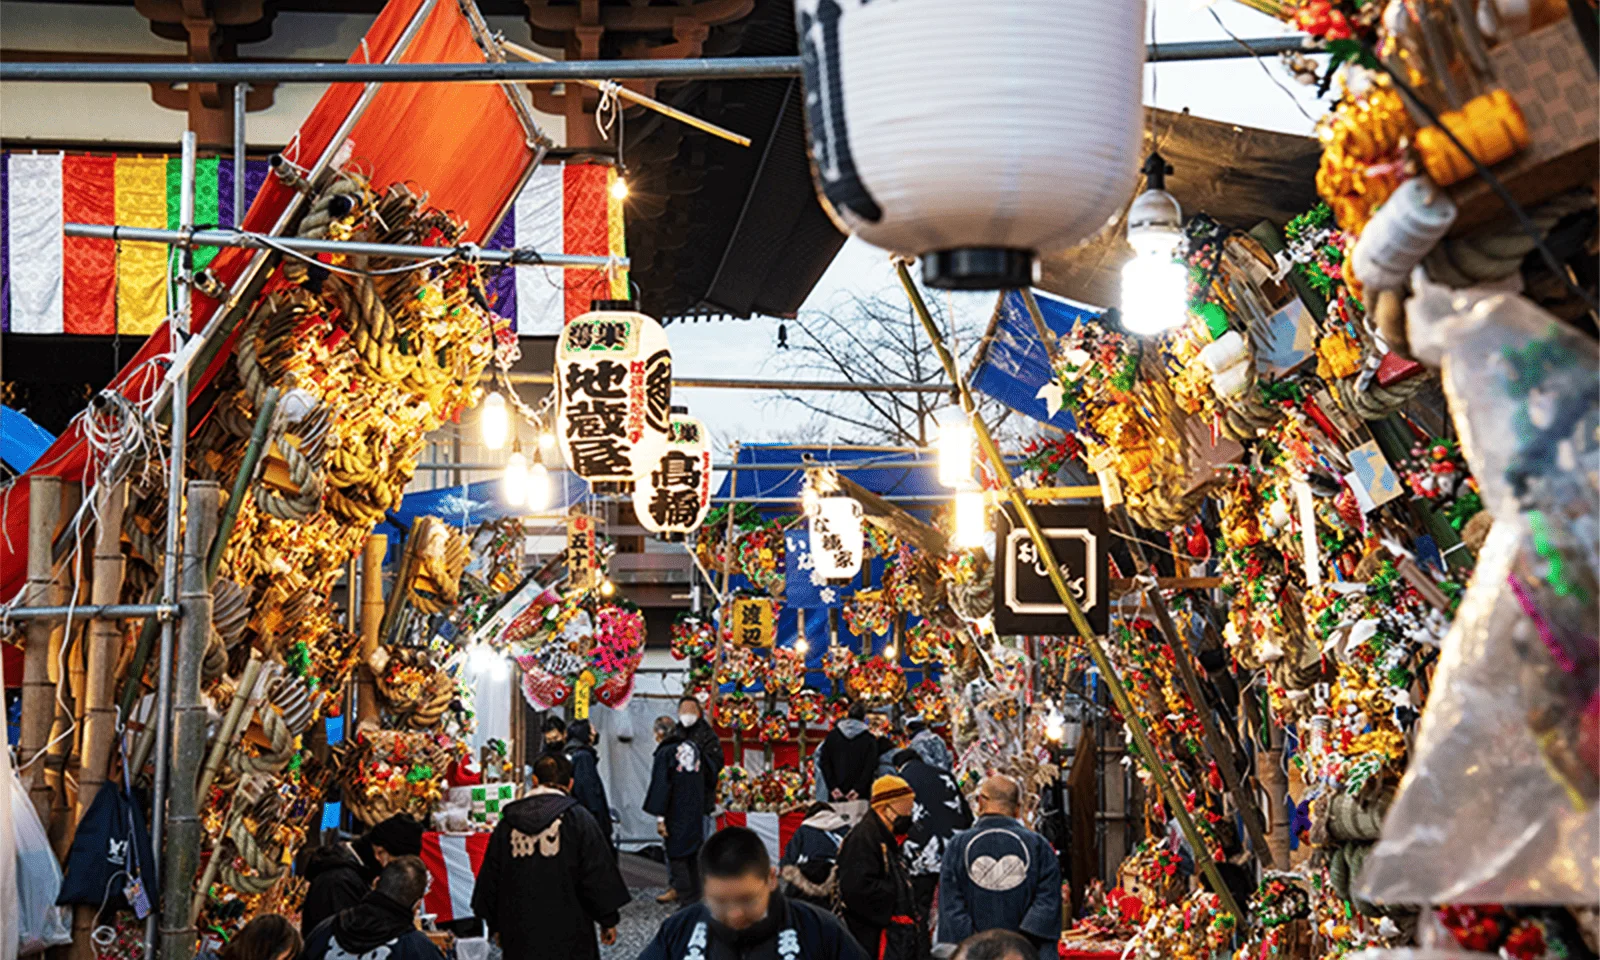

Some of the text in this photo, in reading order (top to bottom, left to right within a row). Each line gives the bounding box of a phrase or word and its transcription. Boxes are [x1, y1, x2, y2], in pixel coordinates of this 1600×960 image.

[565, 360, 633, 477] 地蔵屋
[742, 603, 762, 646] 渡辺
